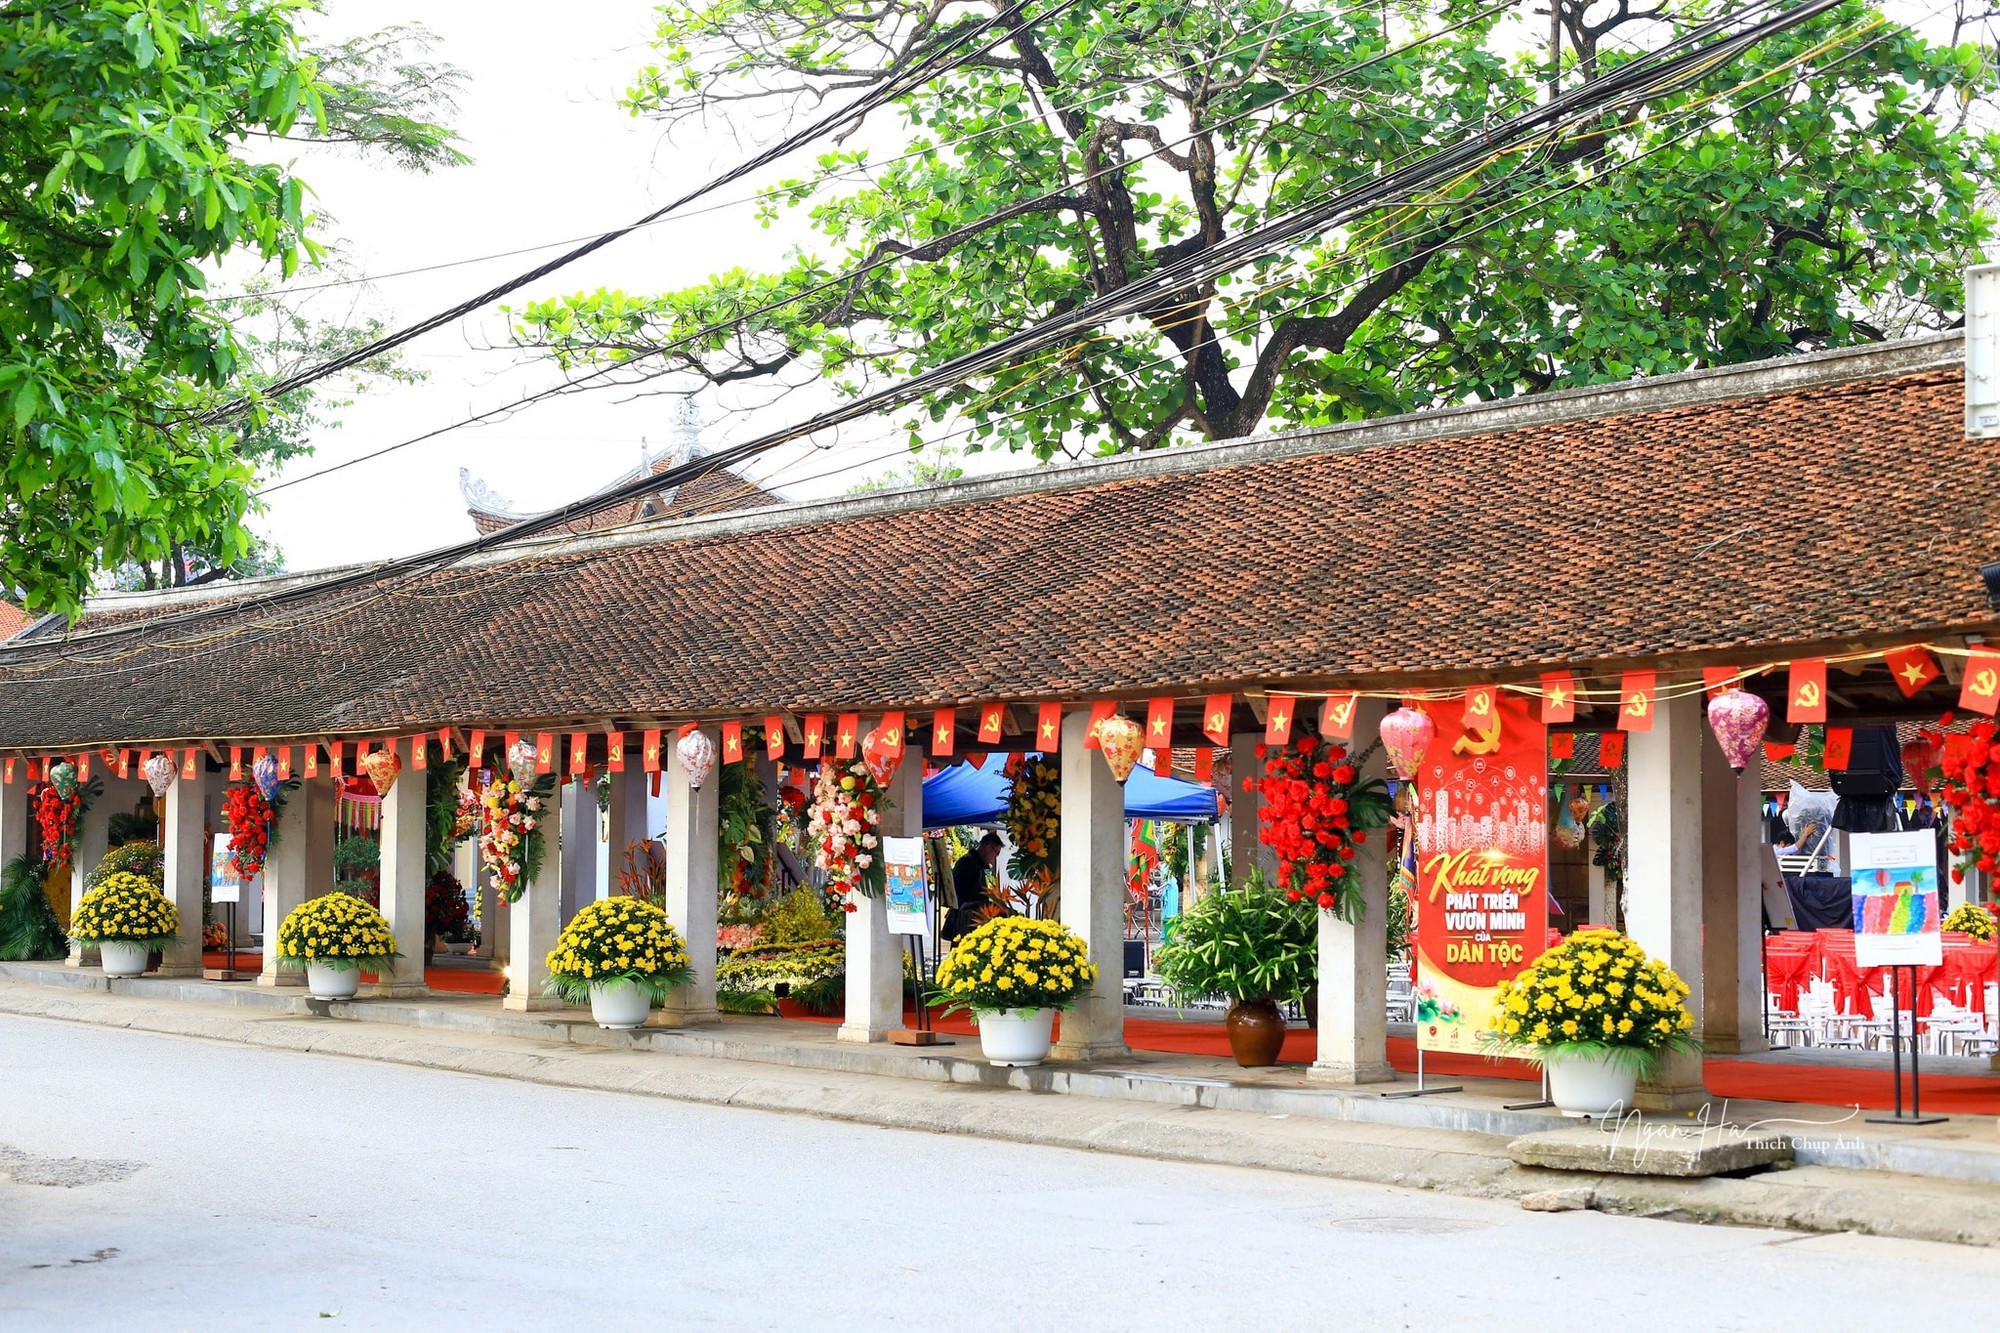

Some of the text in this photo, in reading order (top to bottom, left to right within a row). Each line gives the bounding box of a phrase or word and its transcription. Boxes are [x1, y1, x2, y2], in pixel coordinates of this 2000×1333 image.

[1423, 848, 1540, 903] Khát vọng
[1445, 888, 1519, 910] PHÁT TRIỂN
[1445, 909, 1526, 931] VƯƠN MÌNH
[1474, 931, 1492, 942] CỦA
[1446, 940, 1523, 968] DÂN TỘC
